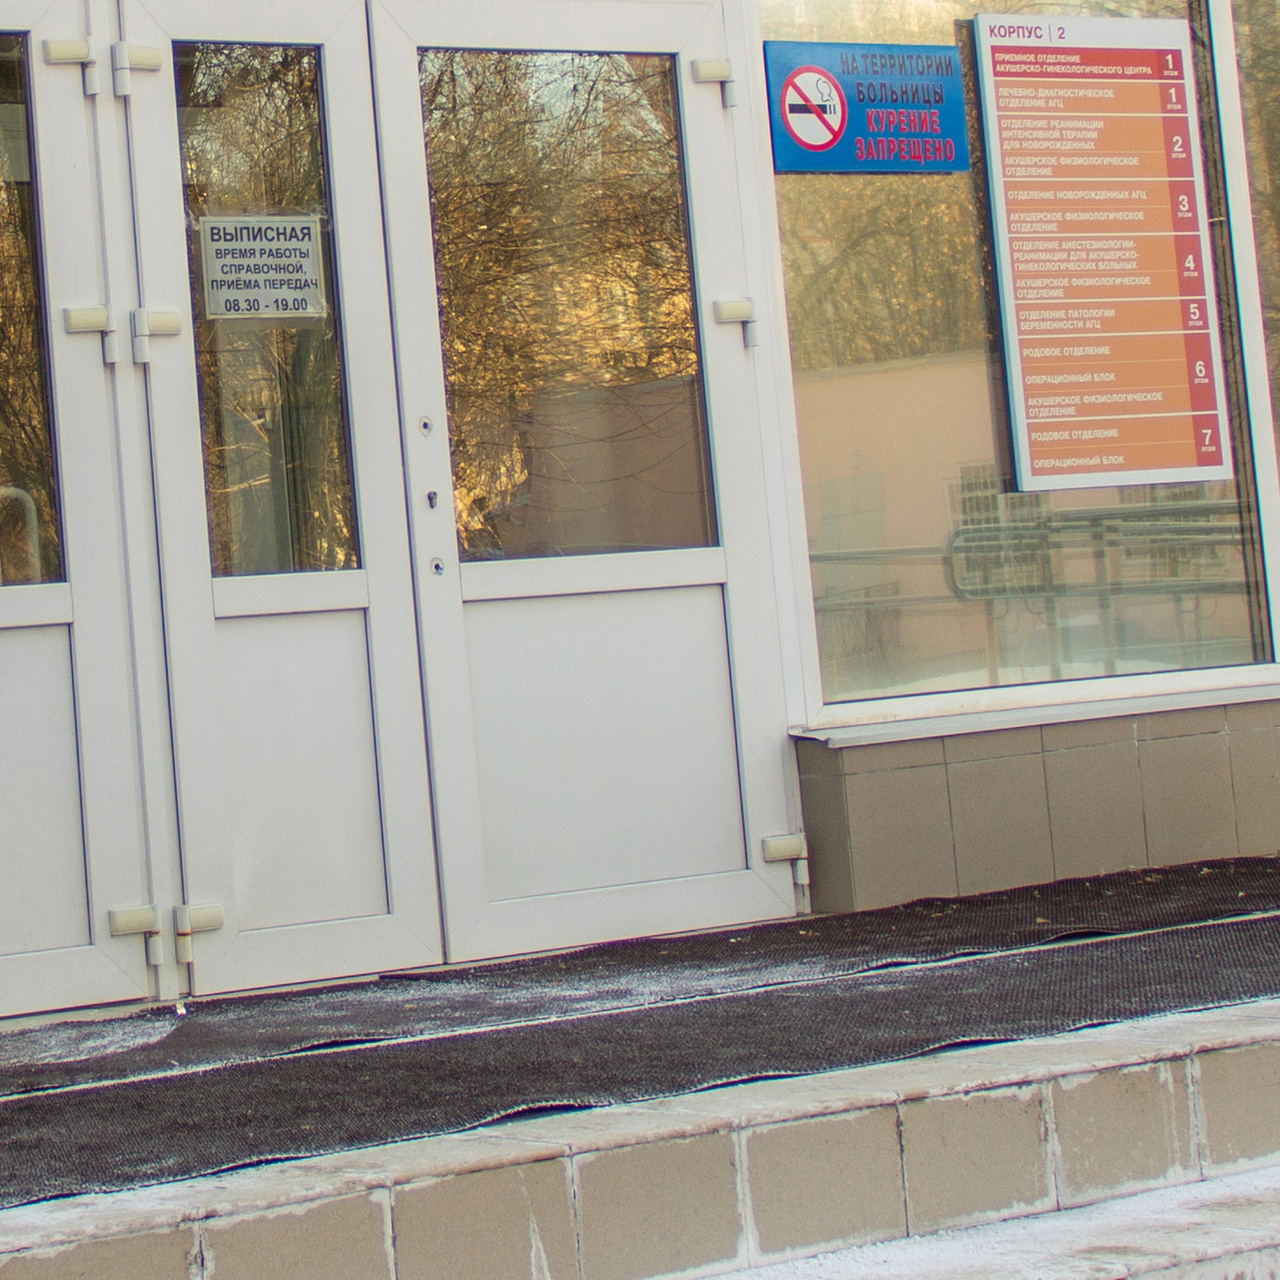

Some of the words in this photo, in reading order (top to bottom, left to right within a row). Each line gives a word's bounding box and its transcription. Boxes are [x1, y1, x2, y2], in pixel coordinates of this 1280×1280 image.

[989, 25, 1043, 40] КОРПУС
[1057, 26, 1066, 40] 2
[995, 53, 1036, 63] ПРИЕМНОЕ
[1037, 54, 1081, 64] ОТДЕЛЕНИЕ
[1165, 54, 1173, 69] 1
[840, 53, 860, 75] НА
[862, 53, 954, 77] ТЕРРИТОРИИ
[996, 64, 1122, 74] АКУШЕРСКО-ГИНЕКОЛОГИЧЕСКОГО
[1124, 66, 1152, 76] ЦЕНТРА
[856, 82, 944, 108] БОЛЬНИЦЫ
[998, 87, 1114, 98] ЛЕЧЕБНО-ДИАГНОСТИЧЕСКОЕ
[1168, 87, 1177, 103] 1
[999, 98, 1046, 108] ОТДЕЛЕНИЕ
[866, 109, 941, 133] КУРЕНИЕ
[1001, 119, 1048, 129] ОТДЕЛЕНИЕ
[1050, 120, 1104, 130] РЕАНИМАЦИИ
[1002, 129, 1061, 139] ИНТЕНСИВНОЙ
[1062, 130, 1098, 139] ТЕРАПИИ
[1003, 140, 1020, 150] ДЛЯ
[1022, 140, 1095, 150] НОВОРОЖДЕННЫХ
[1172, 136, 1183, 152] 2
[855, 137, 955, 165] ЗАПРЕЩЕНО
[1004, 156, 1058, 166] АКУШЕРСКОЕ
[1059, 156, 1139, 166] ФИЗИОЛОГИЧЕСКОЕ
[1005, 166, 1053, 176] ОТДЕЛЕНИЕ
[1008, 190, 1055, 200] ОТДЕЛЕНИЕ
[1056, 190, 1130, 200] НОВОРОЖДЕННЫХ
[1178, 195, 1189, 211] 3
[1010, 212, 1063, 221] АКУШЕРСКОЕ
[1065, 212, 1145, 221] ФИЗИОЛОГИЧЕСКОЕ
[1011, 222, 1058, 232] ОТДЕЛЕНИЕ
[210, 226, 312, 242] ВЫПИСНАЯ
[1013, 241, 1060, 251] ОТДЕЛЕНИЕ
[215, 248, 256, 259] ВРЕМЯ
[259, 248, 310, 259] РАБОТЫ
[1013, 251, 1068, 261] РЕАНИМАЦИИ
[1070, 251, 1087, 261] ДЛЯ
[221, 261, 307, 275] СПРАВОЧНОЙ,
[1014, 261, 1097, 271] ГИНЕКОЛОГИЧЕСКИХ
[1098, 261, 1137, 270] БОЛЬНЫХ
[1184, 255, 1195, 270] 4
[211, 277, 261, 290] ПРИЁМА
[264, 279, 318, 291] ПЕРЕДАЧ
[1016, 277, 1069, 288] АКУШЕРСКОЕ
[1071, 276, 1151, 286] ФИЗИОЛОГИЧЕСКОЕ
[1017, 289, 1064, 299] ОТДЕЛЕНИЕ
[224, 299, 260, 312] 08.30
[273, 298, 308, 311] 19.00
[1019, 310, 1066, 320] ОТДЕЛЕНИЕ
[1068, 309, 1115, 318] ПАТОЛОГИИ
[1189, 304, 1200, 320] 5
[1020, 321, 1083, 330] БЕРЕМЕННОСТИ
[1023, 347, 1062, 358] РОДОВОЕ
[1063, 346, 1110, 356] ОТДЕЛЕНИЕ
[1195, 361, 1206, 377] 6
[1025, 373, 1091, 385] ОПЕРАЦИОННЫЙ
[1093, 372, 1116, 382] БЛОК
[1028, 395, 1081, 406] АКУШЕРСКОЕ
[1083, 392, 1163, 404] ФИЗИОЛОГИЧЕСКОЕ
[1029, 406, 1076, 417] ОТДЕЛЕНИЕ
[1031, 430, 1070, 442] РОДОВОЕ
[1072, 429, 1119, 440] ОТДЕЛЕНИЕ
[1201, 429, 1212, 445] 7
[1034, 456, 1101, 469] ОПЕРАЦИОННЫЙ
[1103, 456, 1125, 465] БЛОК
